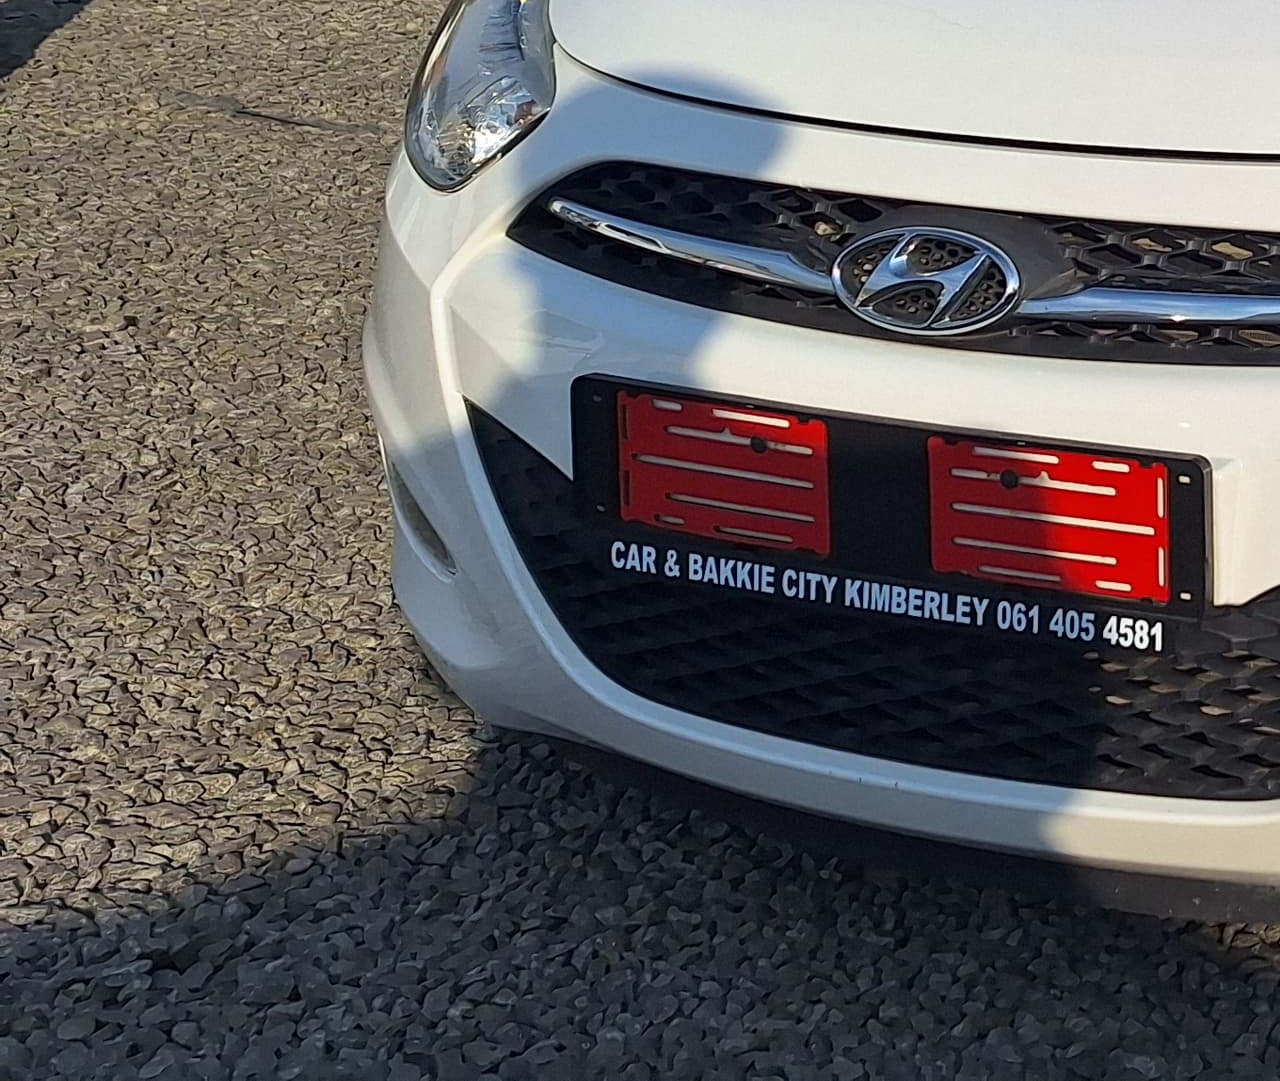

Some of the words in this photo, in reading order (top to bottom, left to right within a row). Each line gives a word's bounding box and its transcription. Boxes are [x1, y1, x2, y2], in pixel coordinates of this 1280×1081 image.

[611, 541, 657, 574] CAR
[664, 549, 681, 578] &
[688, 553, 775, 594] BAKKIE
[782, 569, 838, 604] CITY
[844, 578, 990, 626] KIMBERLEY
[996, 601, 1040, 634] 061
[1049, 608, 1095, 641] 405
[1102, 615, 1163, 652] 4581
